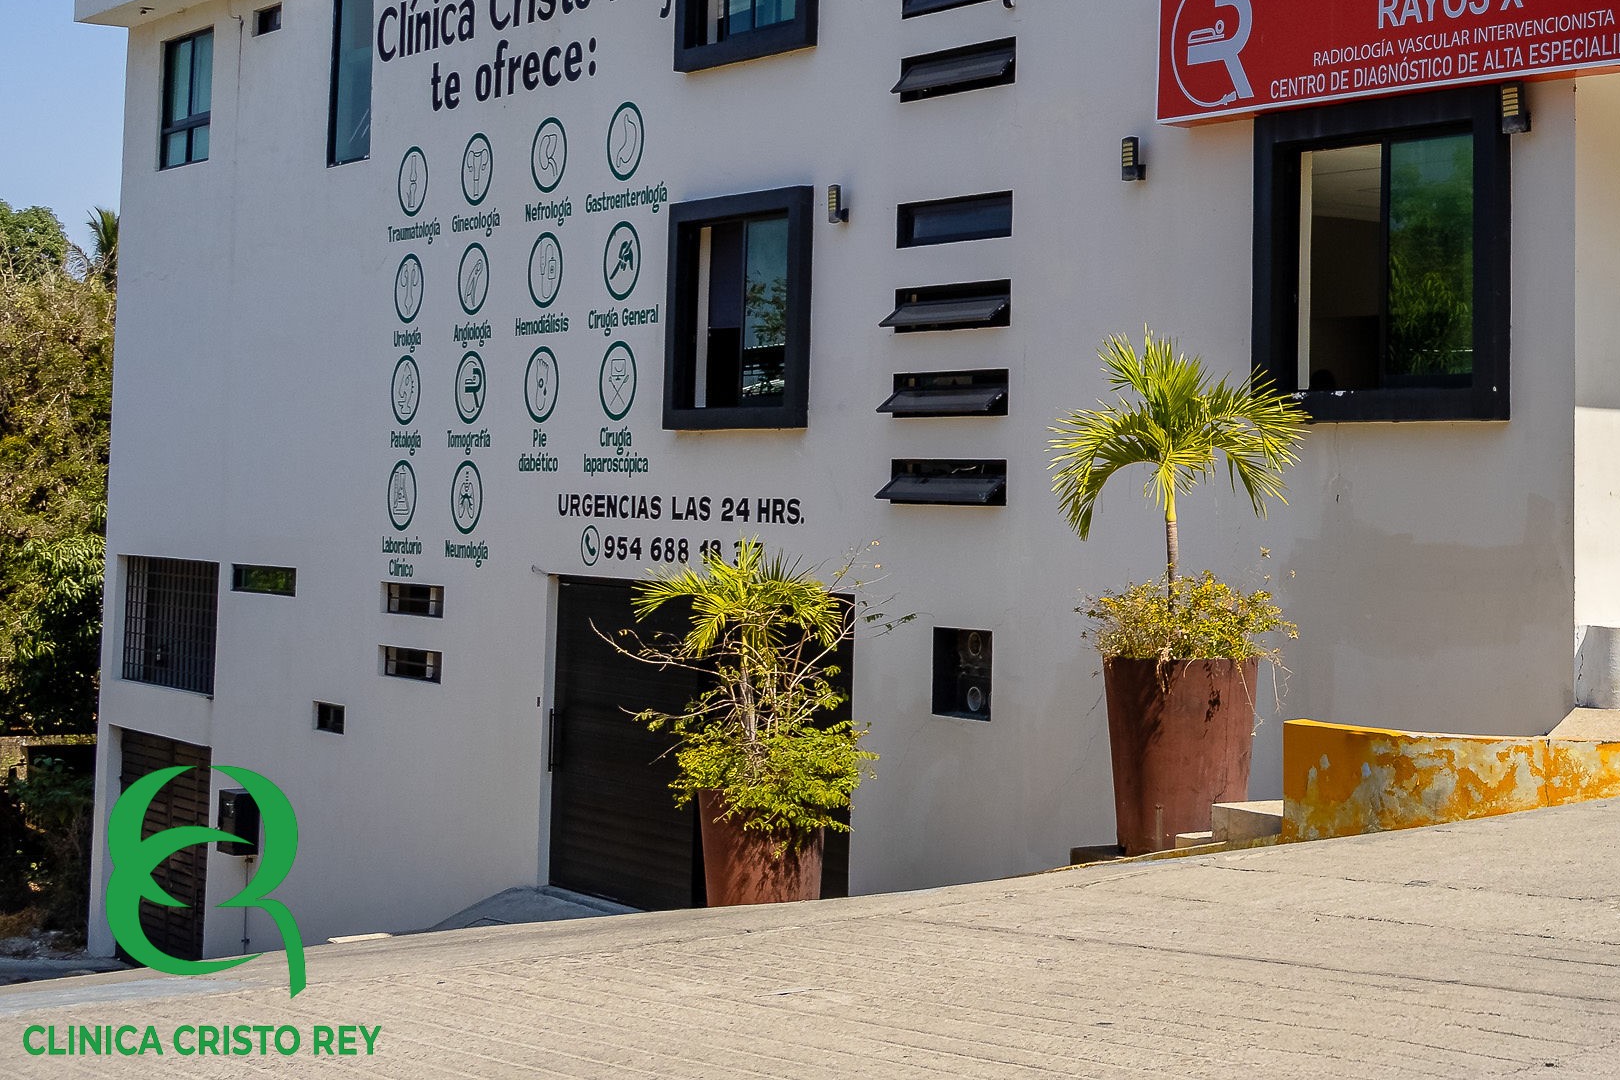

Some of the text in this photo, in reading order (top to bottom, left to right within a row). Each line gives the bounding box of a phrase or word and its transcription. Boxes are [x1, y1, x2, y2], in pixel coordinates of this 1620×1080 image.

[1313, 9, 1615, 67] RADIOLOGÍA VASCULAR INTERVENCIONISTA
[431, 37, 597, 112] te ofrece:
[1270, 69, 1326, 100] CENTRO
[1330, 69, 1349, 92] DE
[1353, 53, 1453, 87] DIAGNÓSTICO
[1458, 53, 1479, 75] DE
[1484, 44, 1523, 71] ALTA
[525, 196, 572, 226] Nefrología
[585, 181, 668, 213] Gastroenterología
[388, 217, 441, 244] Traumatología
[452, 208, 500, 237] Ginecología
[515, 312, 569, 337] Hemodiálisis
[588, 304, 659, 337] Cirugía General
[393, 327, 421, 353] Urología
[390, 429, 422, 456] Patología
[447, 428, 491, 455] Tomografía
[532, 428, 547, 448] Pie
[600, 426, 632, 454] Cirugía
[518, 452, 558, 473] diabético
[583, 452, 648, 478] laparoscópica
[558, 493, 805, 525] URGENCIAS LAS 24 HRS.
[382, 536, 422, 555] Laboratorio
[445, 539, 488, 568] Neumología
[604, 535, 642, 561] 954
[650, 537, 689, 564] 688
[389, 558, 413, 577] Clínico
